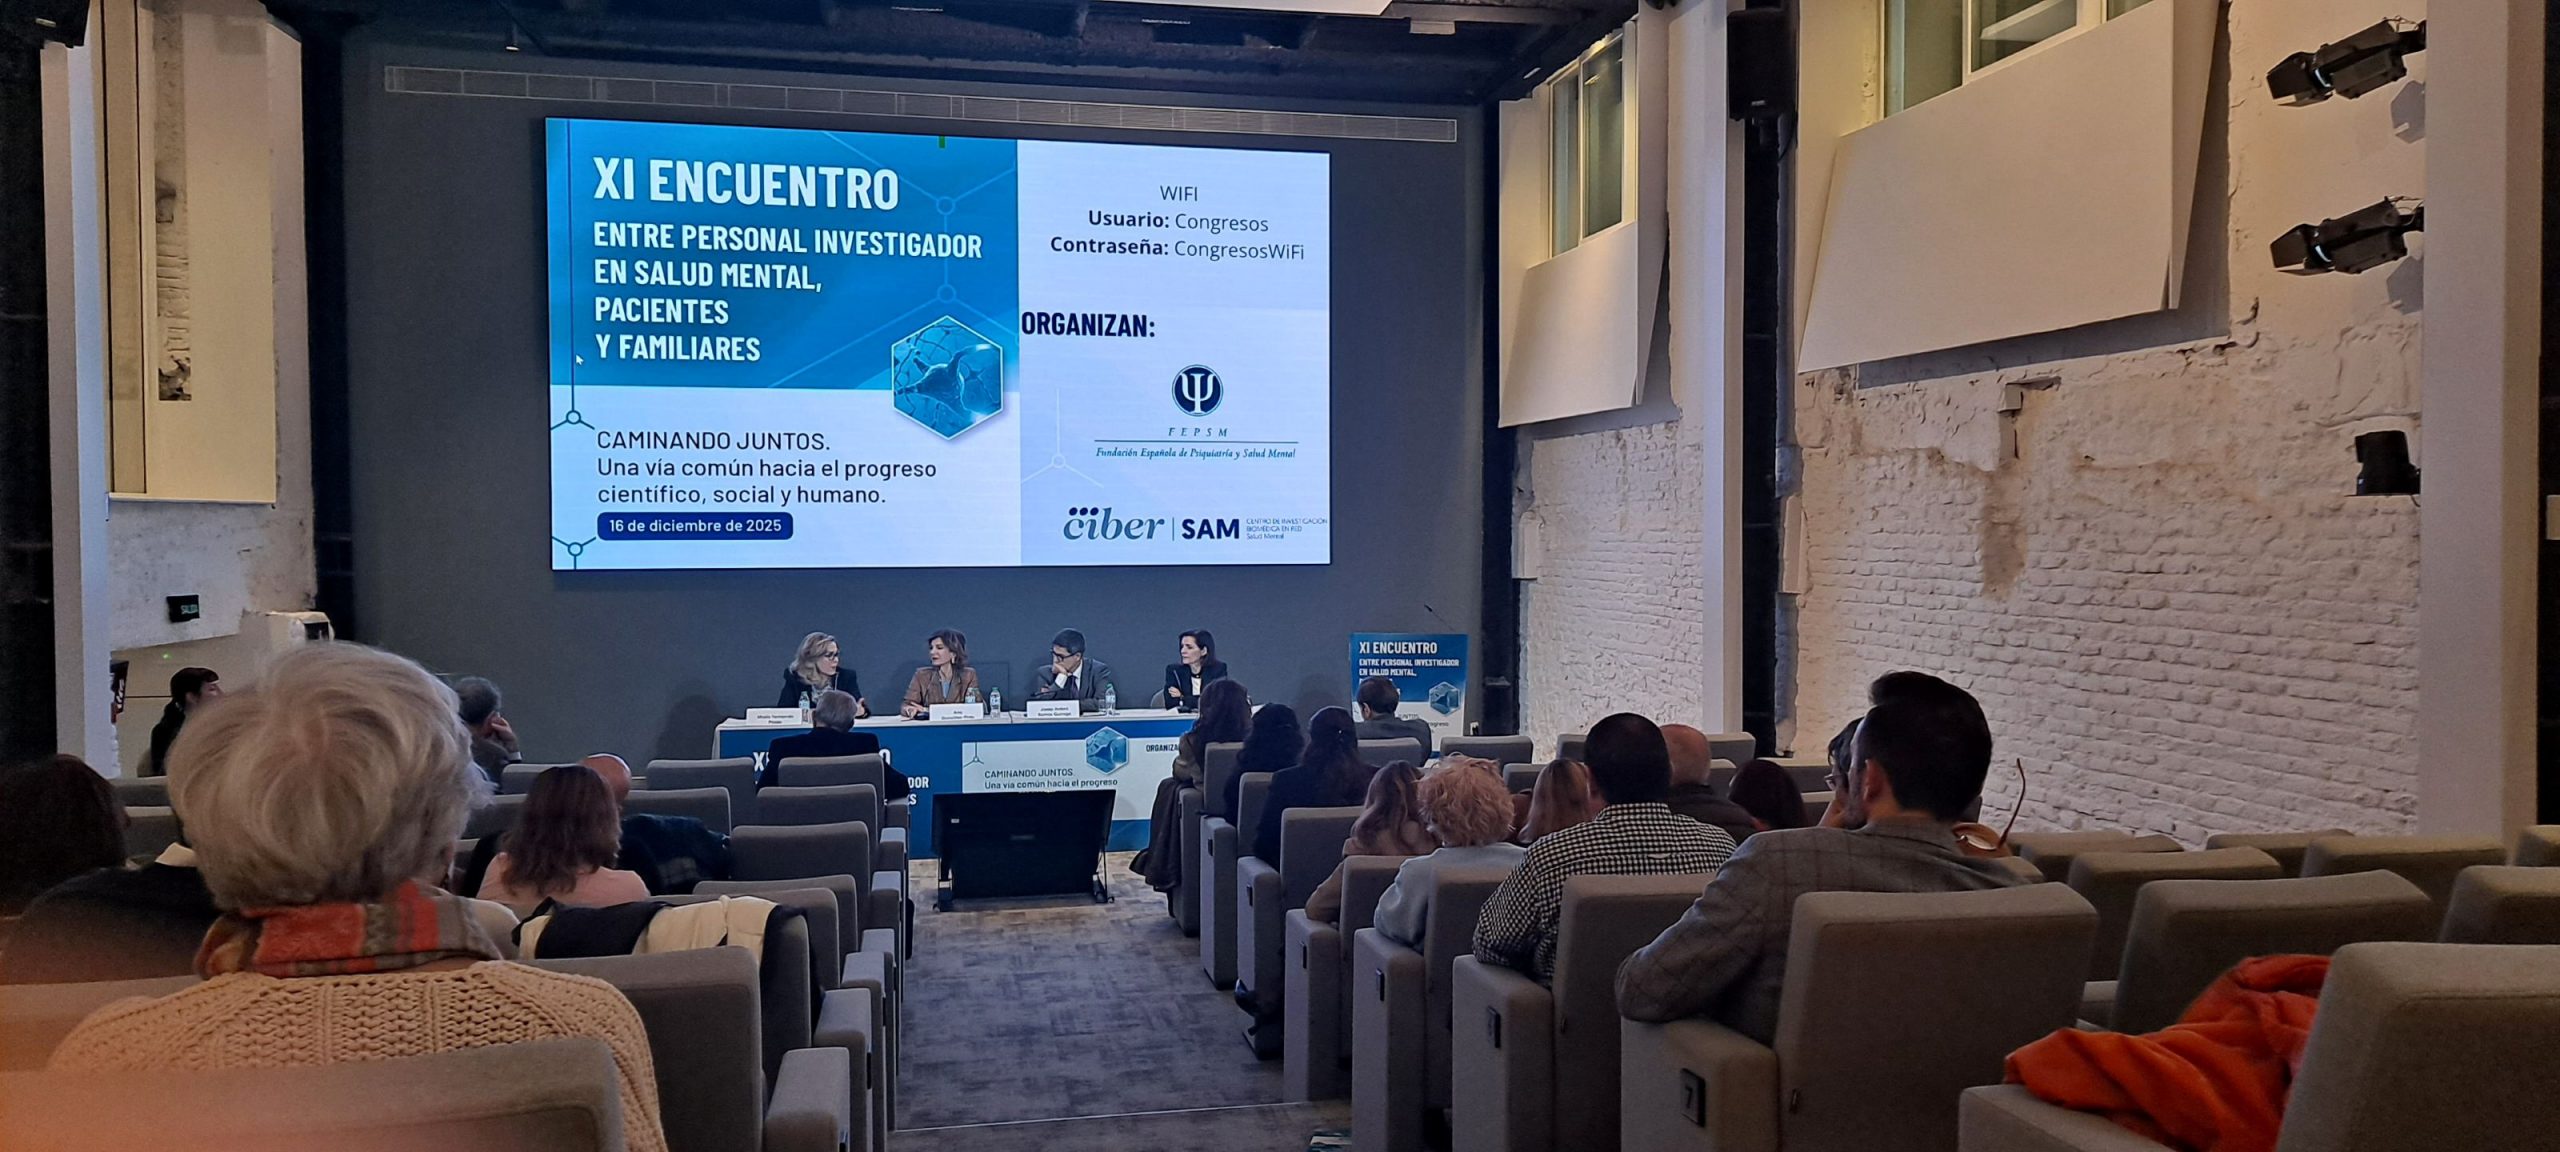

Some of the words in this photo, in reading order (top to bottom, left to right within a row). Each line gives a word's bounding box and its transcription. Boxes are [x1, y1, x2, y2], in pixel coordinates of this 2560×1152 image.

[593, 157, 635, 201] XI
[650, 160, 899, 210] ENCUENTRO
[1160, 185, 1198, 202] WIFI
[1088, 210, 1170, 228] Usuario:
[1174, 213, 1269, 235] Congresos
[593, 222, 673, 248] ENTRE
[682, 225, 808, 253] PERSONAL
[814, 230, 983, 258] INVESTIGADOR
[1050, 236, 1169, 256] Contraseña:
[1174, 240, 1304, 261] CongresosWiFi
[594, 260, 626, 285] EN
[635, 262, 713, 287] SALUD
[721, 264, 822, 293] MENTAL,
[595, 297, 729, 325] PACIENTES
[1021, 312, 1156, 337] ORGANIZAN:
[596, 333, 611, 359] Y
[619, 335, 761, 362] FAMILIARES
[597, 431, 731, 450] CAMINANDO
[737, 433, 831, 451] JUNTOS.
[1096, 447, 1138, 457] Fundación
[1141, 448, 1177, 460] Española
[1178, 449, 1188, 457] de
[1234, 450, 1240, 460] y
[1243, 448, 1266, 458] Salud
[1268, 448, 1296, 458] Mental
[597, 458, 639, 477] Una
[645, 458, 675, 477] vía
[681, 457, 754, 478] común
[760, 459, 815, 478] hacia
[821, 460, 838, 478] el
[845, 464, 937, 482] progreso
[597, 484, 706, 504] científico,
[713, 485, 774, 503] social
[780, 490, 792, 507] y
[798, 486, 887, 503] humano.
[609, 518, 624, 532] 16
[627, 518, 646, 532] de
[649, 518, 722, 532] diciembre
[725, 518, 743, 532] de
[746, 519, 782, 533] 2025
[1181, 518, 1240, 539] SAM
[1360, 642, 1370, 654] XI
[1373, 642, 1437, 654] ENCUENTRO
[1381, 659, 1413, 667] PERSONAL
[1415, 659, 1459, 667] INVESTIGADOR
[985, 770, 1036, 778] CAMINANDO
[985, 781, 1001, 789] Una
[1047, 779, 1070, 787] hacia
[1081, 779, 1118, 787] progreso
